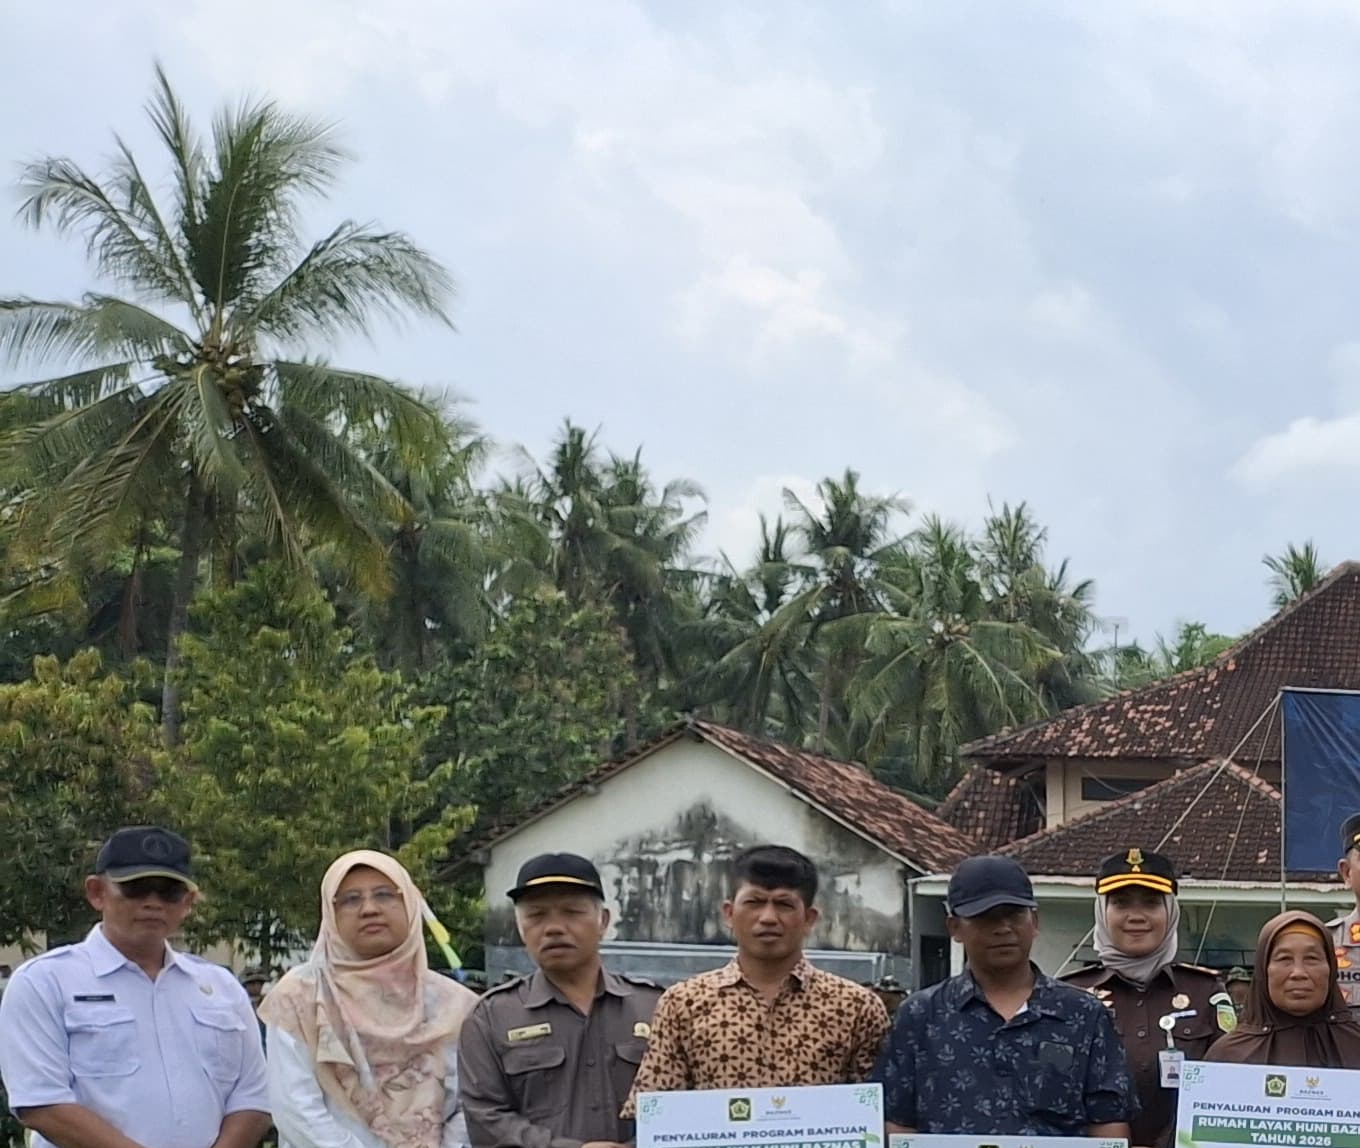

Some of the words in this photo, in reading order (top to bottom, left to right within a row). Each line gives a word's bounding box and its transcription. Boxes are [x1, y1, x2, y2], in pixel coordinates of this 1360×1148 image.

[1192, 1101, 1271, 1114] PENYALURAN
[1276, 1106, 1334, 1118] PROGRAM
[1198, 1117, 1247, 1129] RUMAH
[1249, 1119, 1293, 1131] LAYAK
[1295, 1122, 1328, 1133] HUNI
[653, 1131, 736, 1142] PENYALURAN
[742, 1129, 804, 1139] PROGRAM
[807, 1126, 868, 1136] BANTUAN
[1250, 1133, 1297, 1145] TAHUN
[1299, 1135, 1332, 1147] 2026
